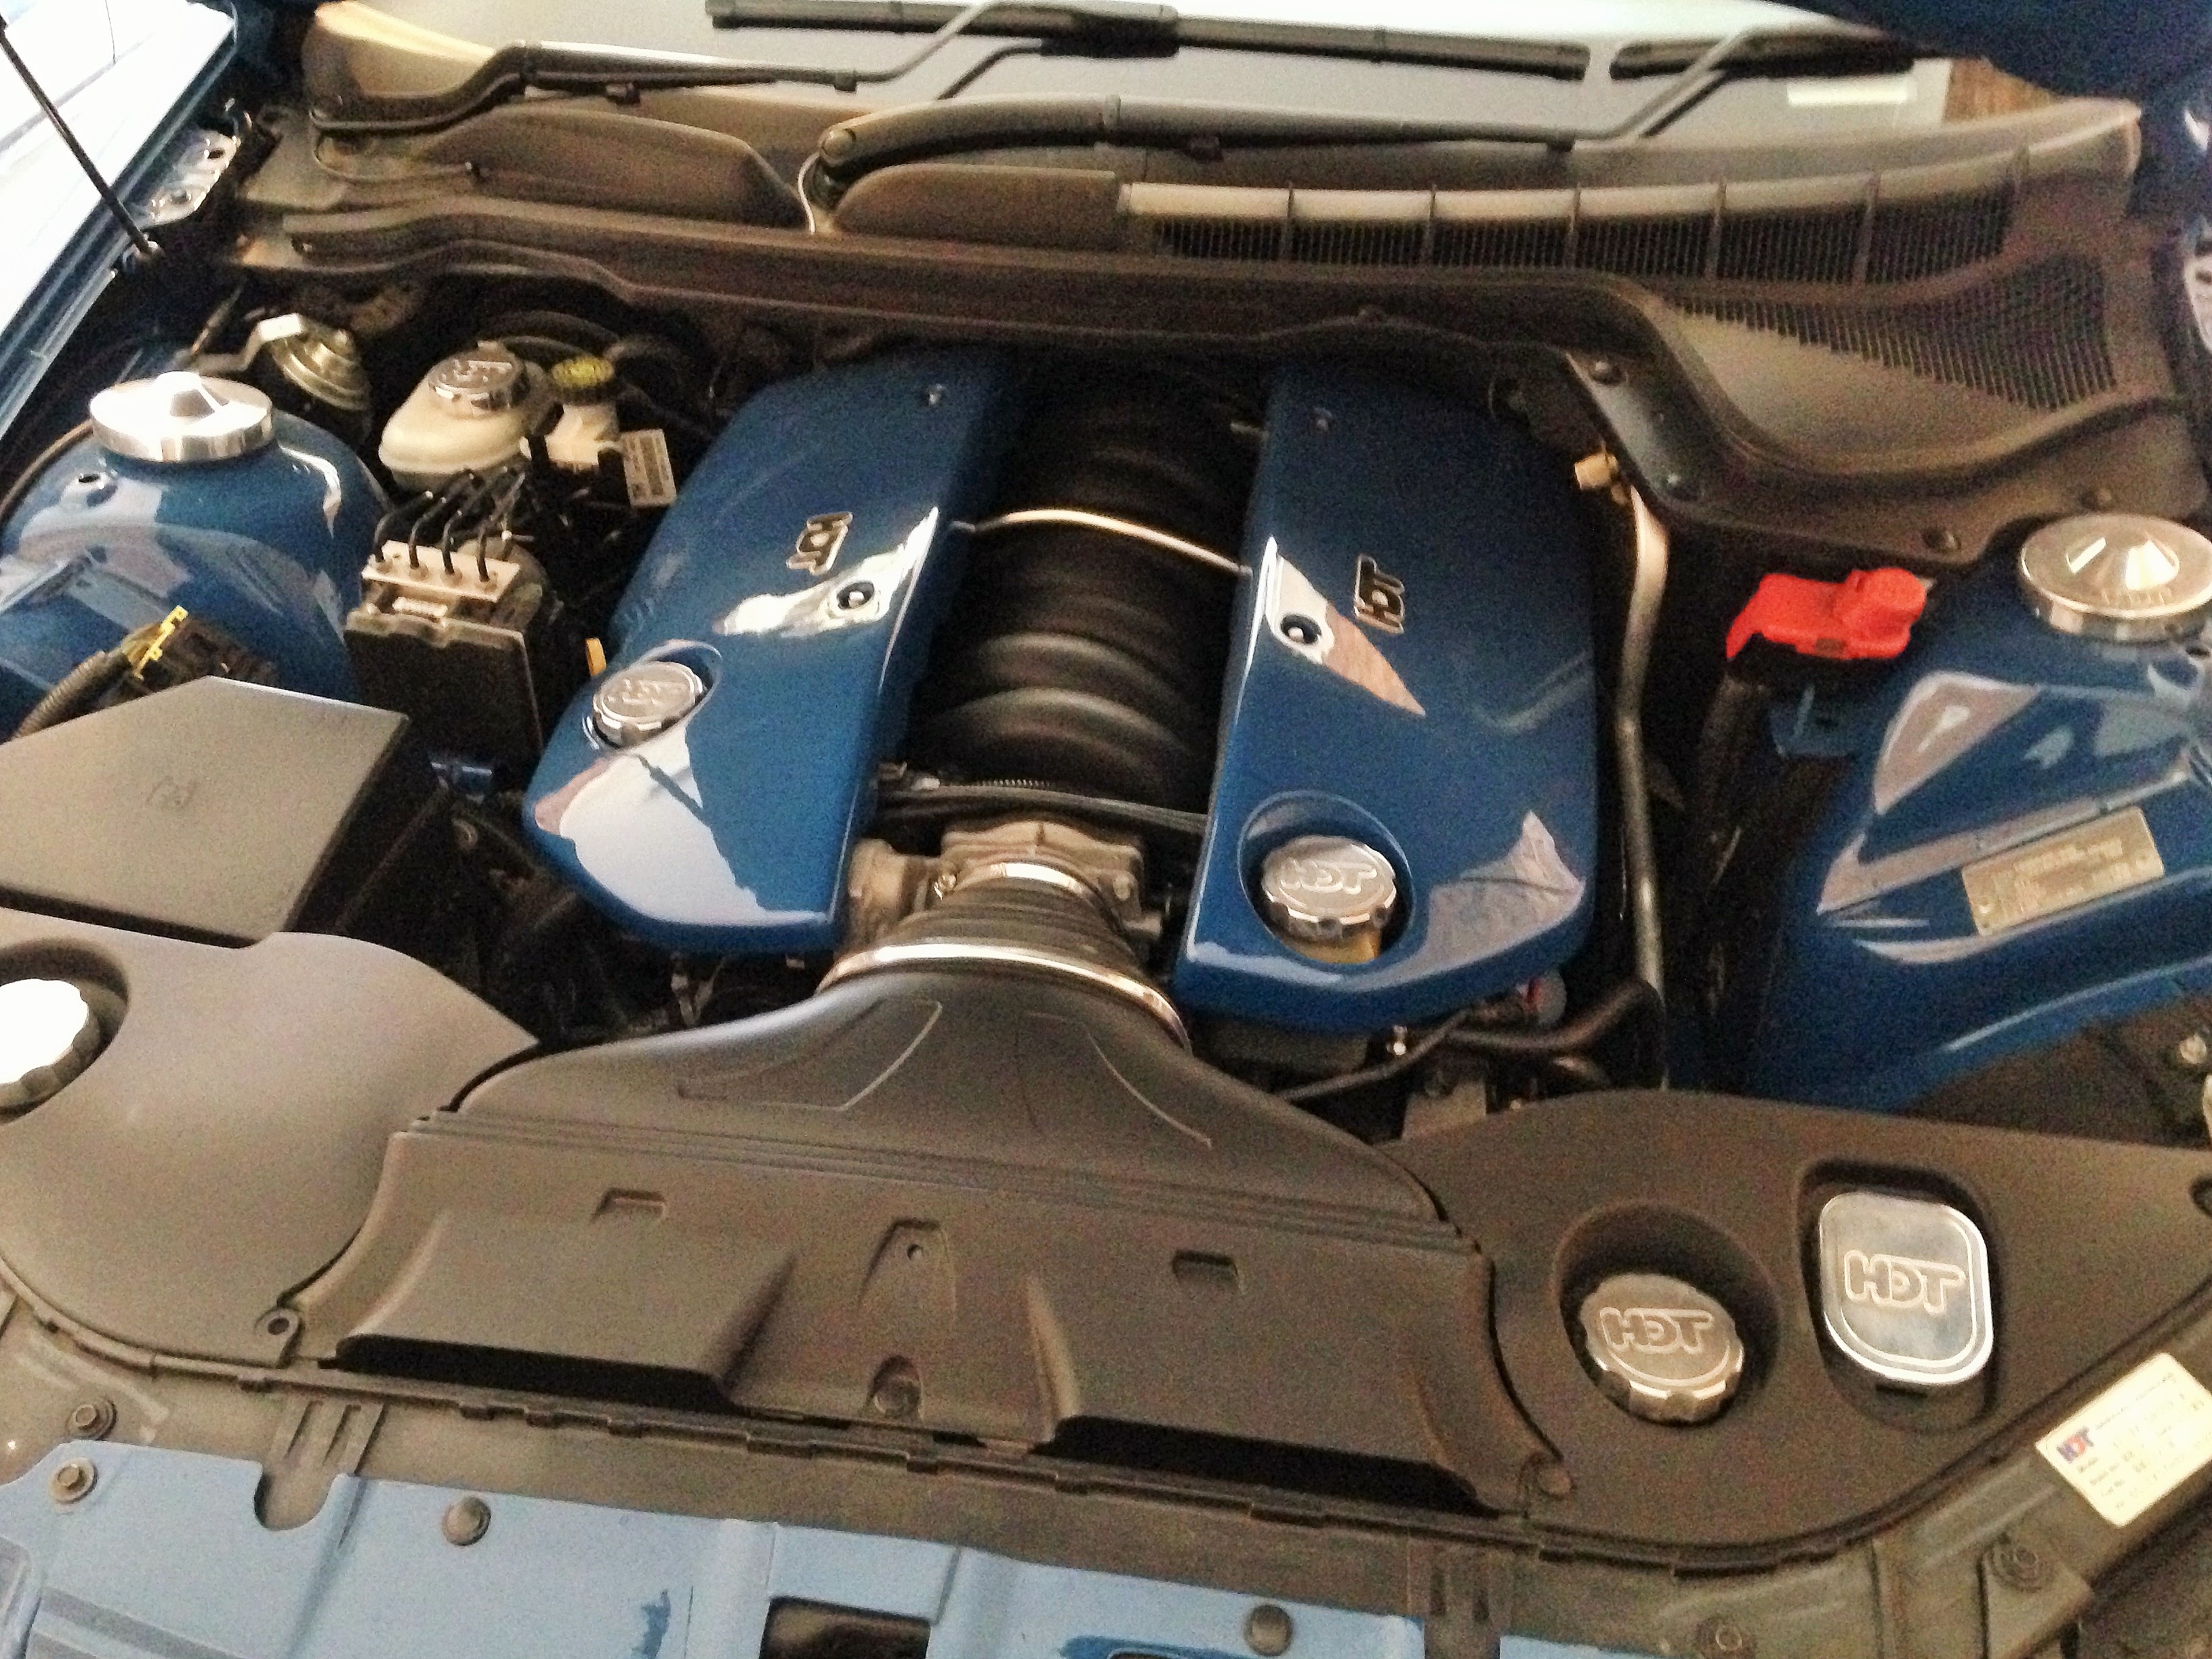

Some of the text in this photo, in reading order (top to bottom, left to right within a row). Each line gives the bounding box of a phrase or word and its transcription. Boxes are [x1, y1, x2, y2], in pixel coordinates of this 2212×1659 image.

[1279, 856, 1378, 895] HDT
[1843, 1250, 1965, 1315] HDT
[1599, 1307, 1713, 1355] HDT
